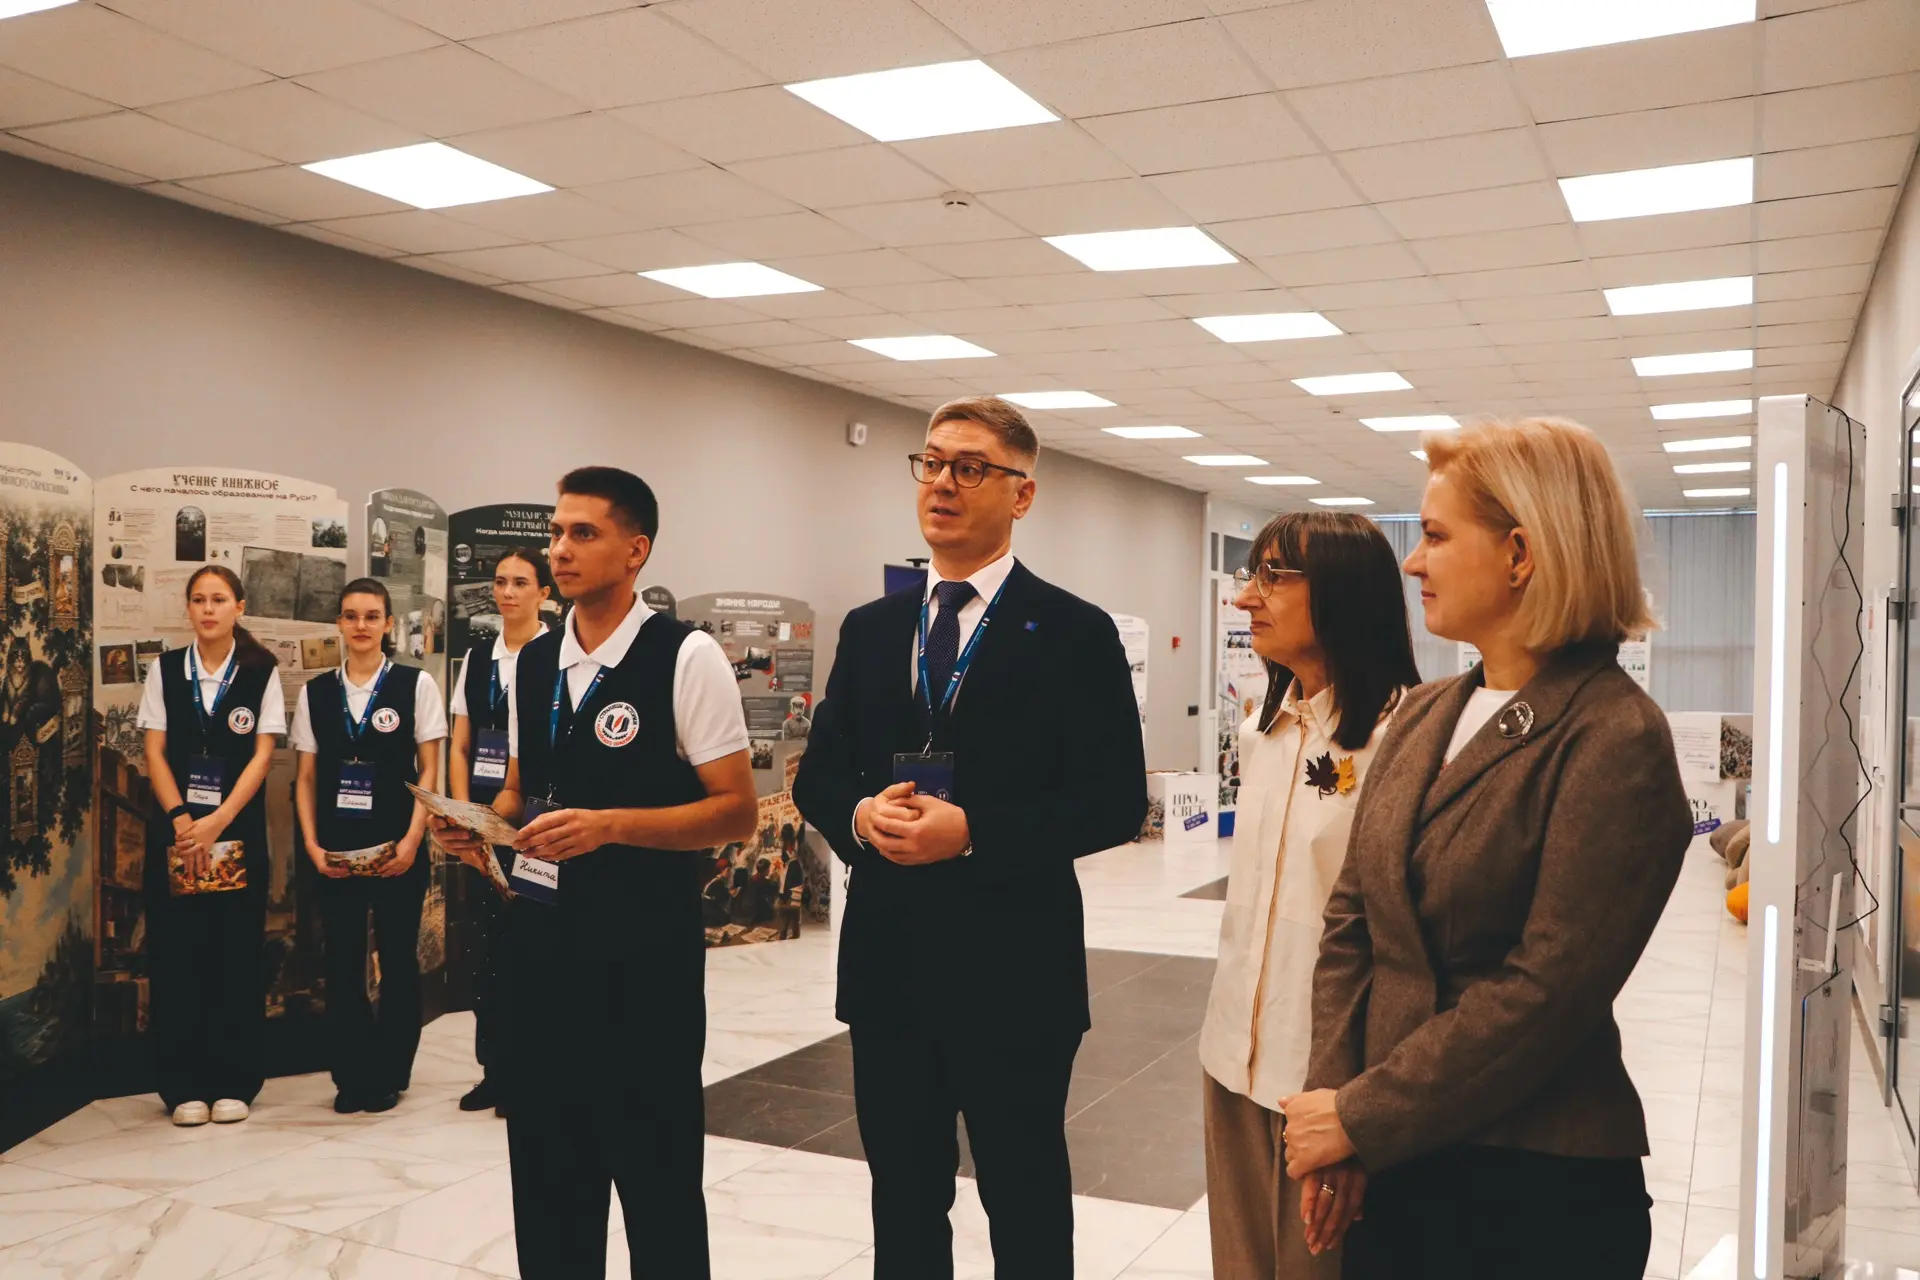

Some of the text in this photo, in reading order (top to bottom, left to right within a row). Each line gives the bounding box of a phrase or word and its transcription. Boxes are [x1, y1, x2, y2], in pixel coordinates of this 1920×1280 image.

[222, 477, 280, 490] КНИЖНОЕ
[130, 484, 138, 492] С
[164, 488, 210, 496] началось
[212, 490, 273, 499] образование
[290, 493, 318, 502] Руси?
[475, 527, 498, 535] Когда
[1688, 798, 1708, 810] РО
[519, 859, 557, 882] Никита
